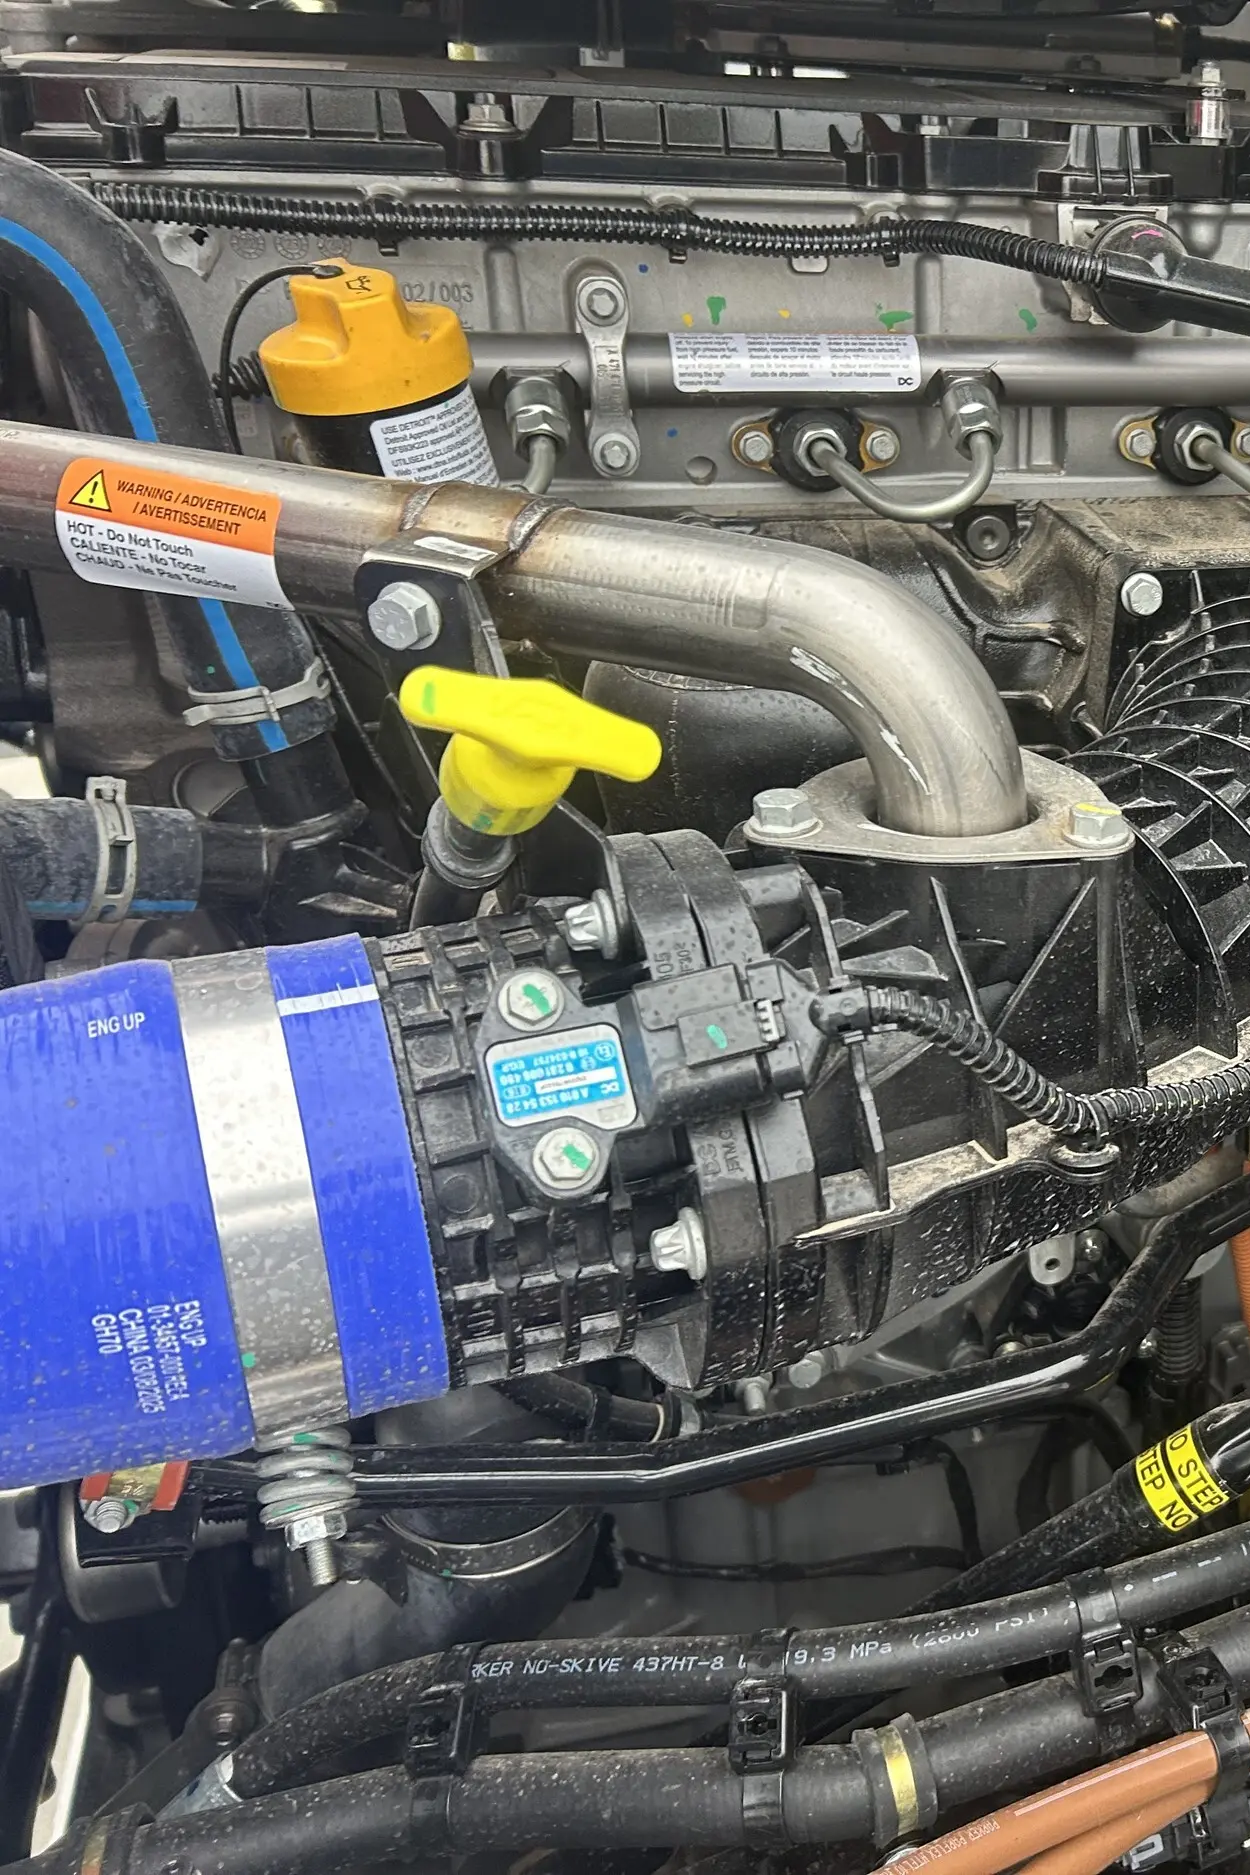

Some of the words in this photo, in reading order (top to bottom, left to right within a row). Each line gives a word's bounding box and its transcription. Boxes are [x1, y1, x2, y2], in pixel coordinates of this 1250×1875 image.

[897, 377, 914, 386] DC
[117, 480, 172, 502] WARNING
[181, 494, 267, 521] ADVERTENCIA
[139, 504, 241, 535] AVERTISSEMENT
[67, 520, 94, 536] HOT
[107, 529, 125, 543] Do
[128, 533, 152, 548] Not
[152, 538, 194, 557] Touch
[70, 537, 138, 560] CALIENTE
[149, 553, 169, 566] No
[169, 557, 206, 573] Tocar
[76, 552, 125, 569] CHAUD
[135, 564, 154, 576] Ne
[157, 568, 183, 581] Pas
[185, 574, 237, 592] Toucher
[87, 1015, 120, 1038] ENG
[123, 1011, 146, 1031] UP
[174, 1300, 204, 1330] ENG
[92, 1313, 123, 1354] GH70
[118, 1308, 150, 1356] CHINA
[180, 1329, 207, 1347] UP
[1178, 1458, 1224, 1507] STEP
[1159, 1500, 1193, 1529] NO
[850, 1640, 893, 1660] MPa
[523, 1656, 625, 1676] NO-SKIVE
[632, 1655, 724, 1672] 437HT-8
[968, 1819, 1000, 1841] PARKER
[930, 1835, 968, 1860] PARFLEX
